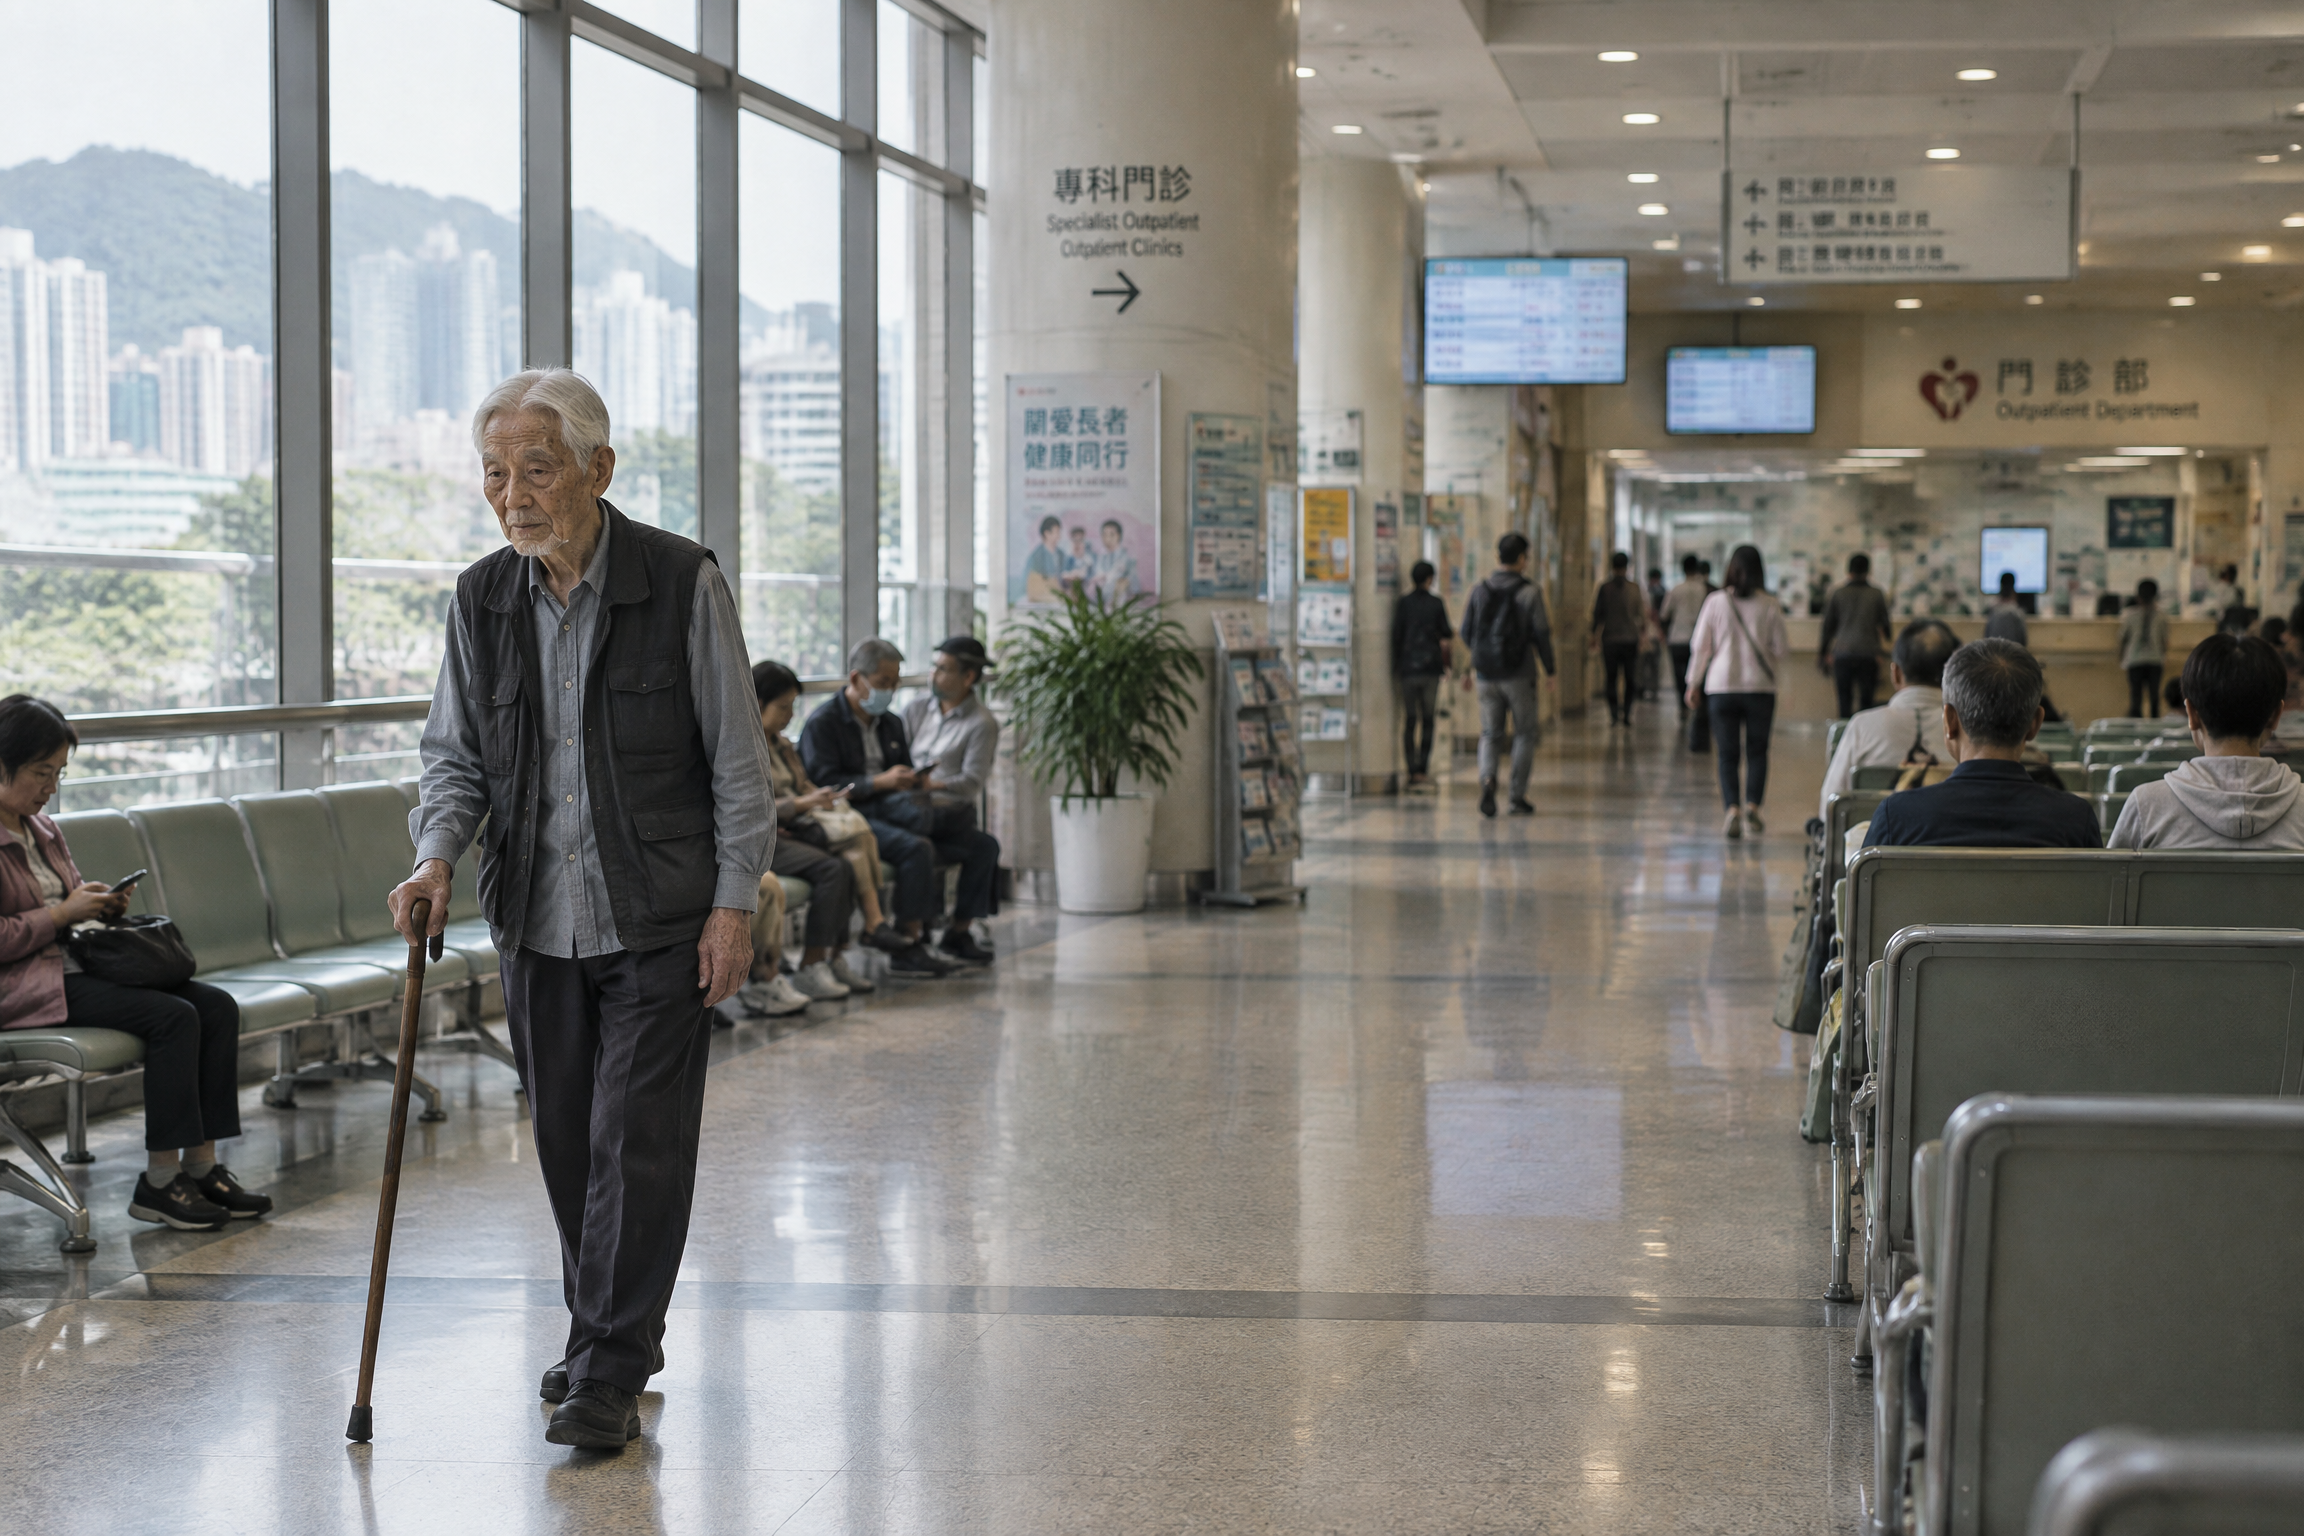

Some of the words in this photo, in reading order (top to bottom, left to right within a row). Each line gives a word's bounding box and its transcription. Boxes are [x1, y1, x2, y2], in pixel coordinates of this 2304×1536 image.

[1054, 165, 1192, 204] 專科門診
[1046, 211, 1119, 234] Specialist
[1122, 210, 1200, 233] Outpatient
[1996, 356, 2150, 396] 門診部
[1024, 440, 1129, 471] 健康同行
